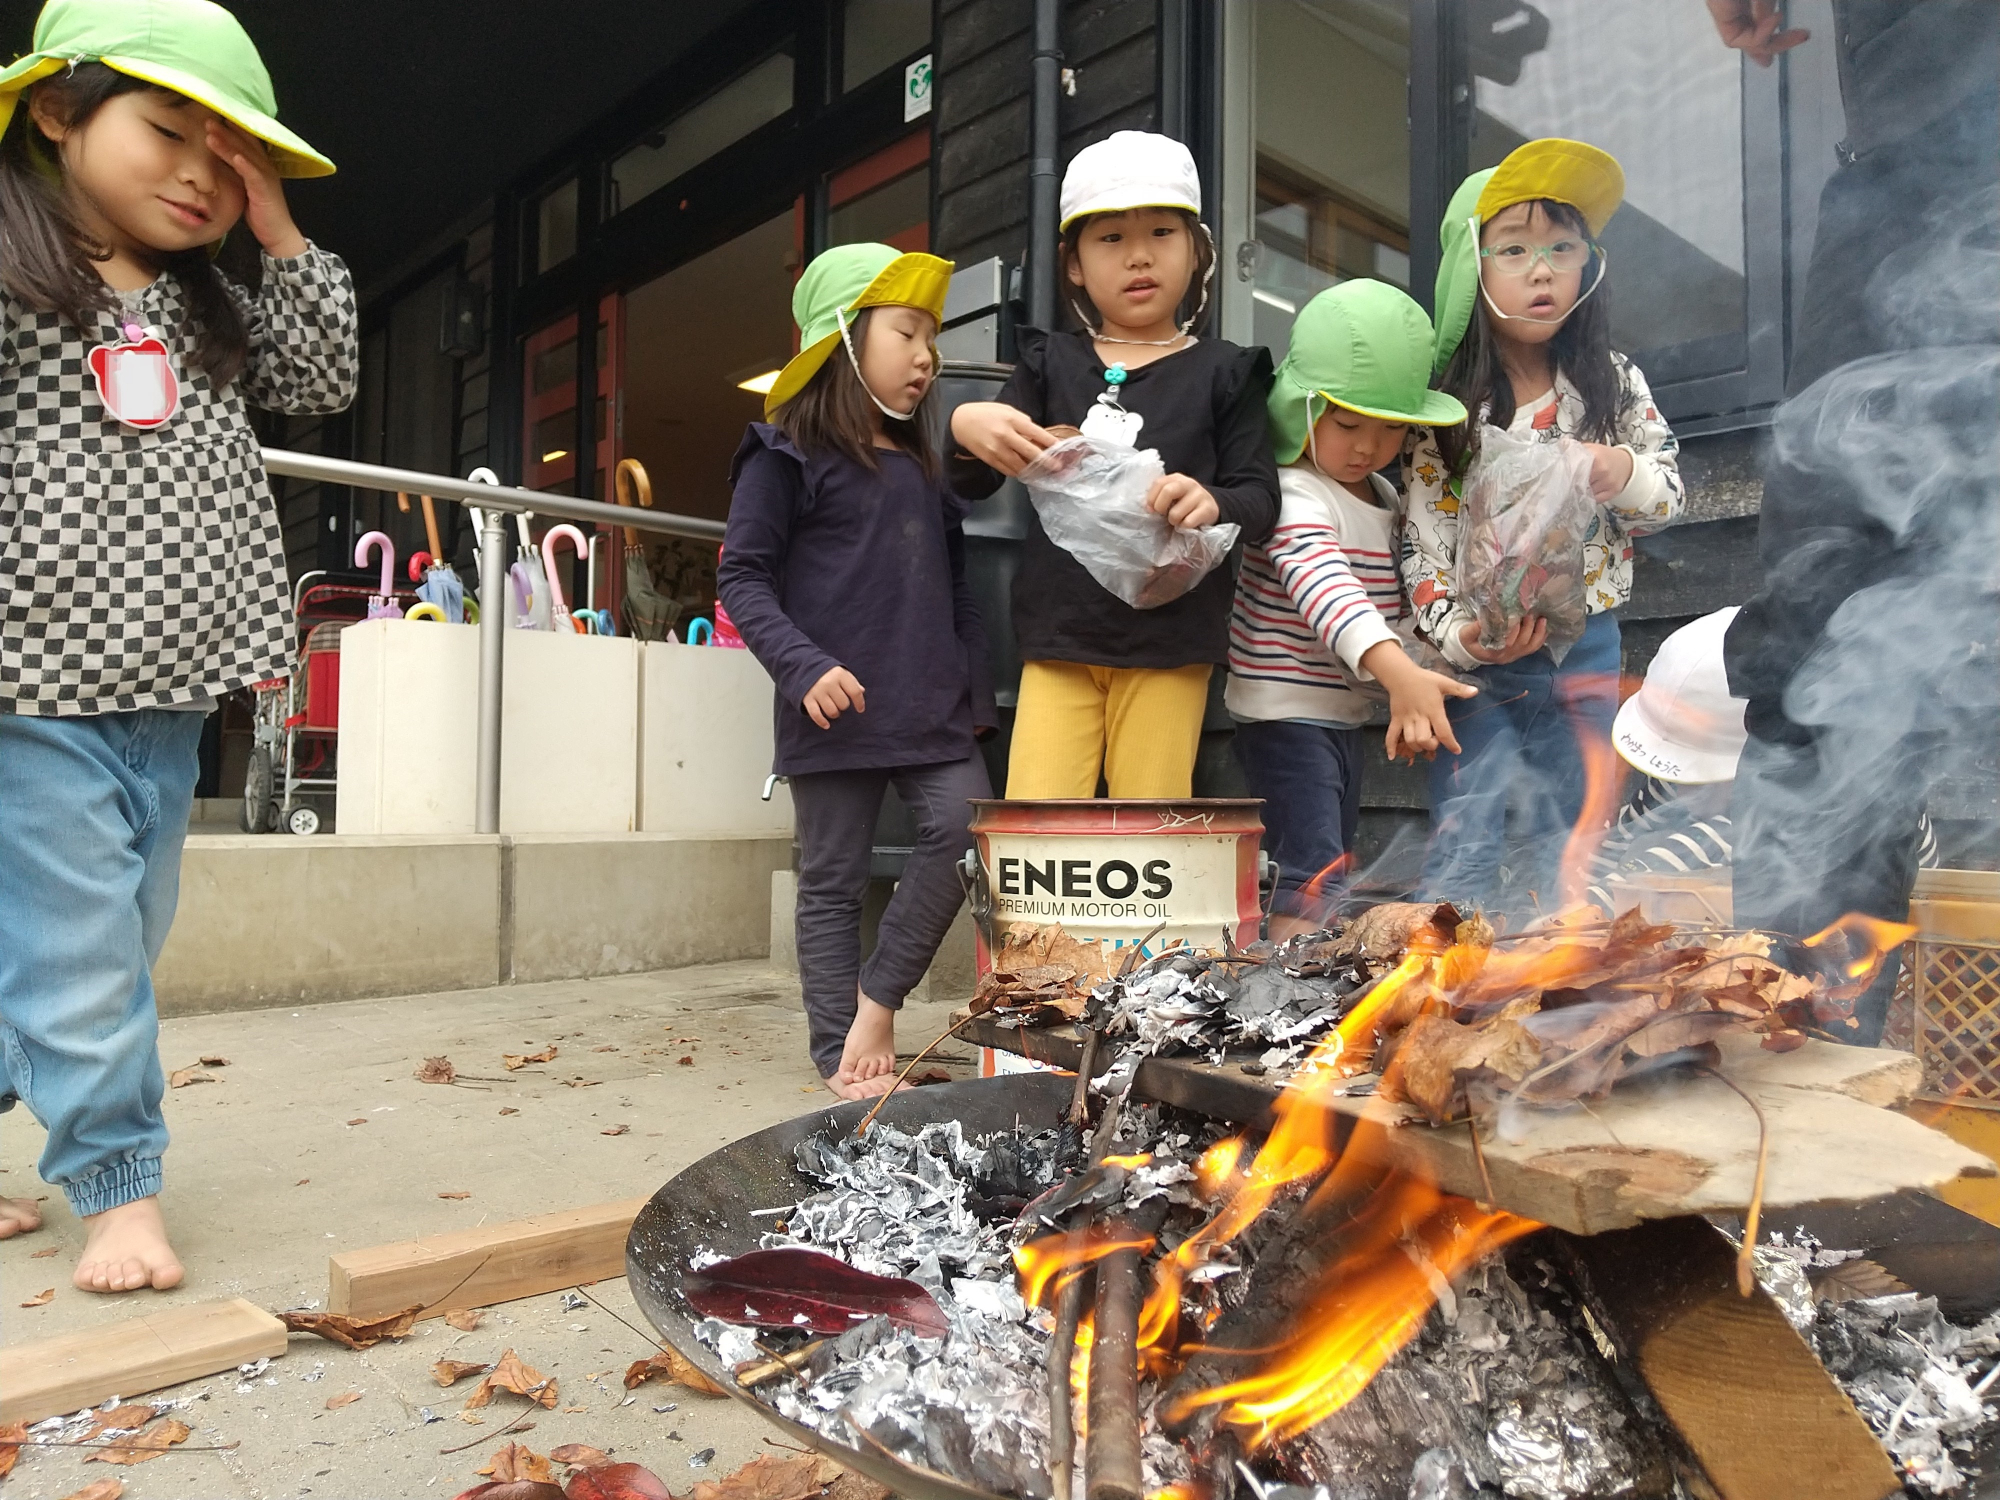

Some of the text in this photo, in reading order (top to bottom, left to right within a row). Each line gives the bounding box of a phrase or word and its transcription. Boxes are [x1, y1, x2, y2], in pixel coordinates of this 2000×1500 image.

[998, 857, 1173, 900] ENEOS
[998, 898, 1172, 919] PREMIUM MOTOR OIL
